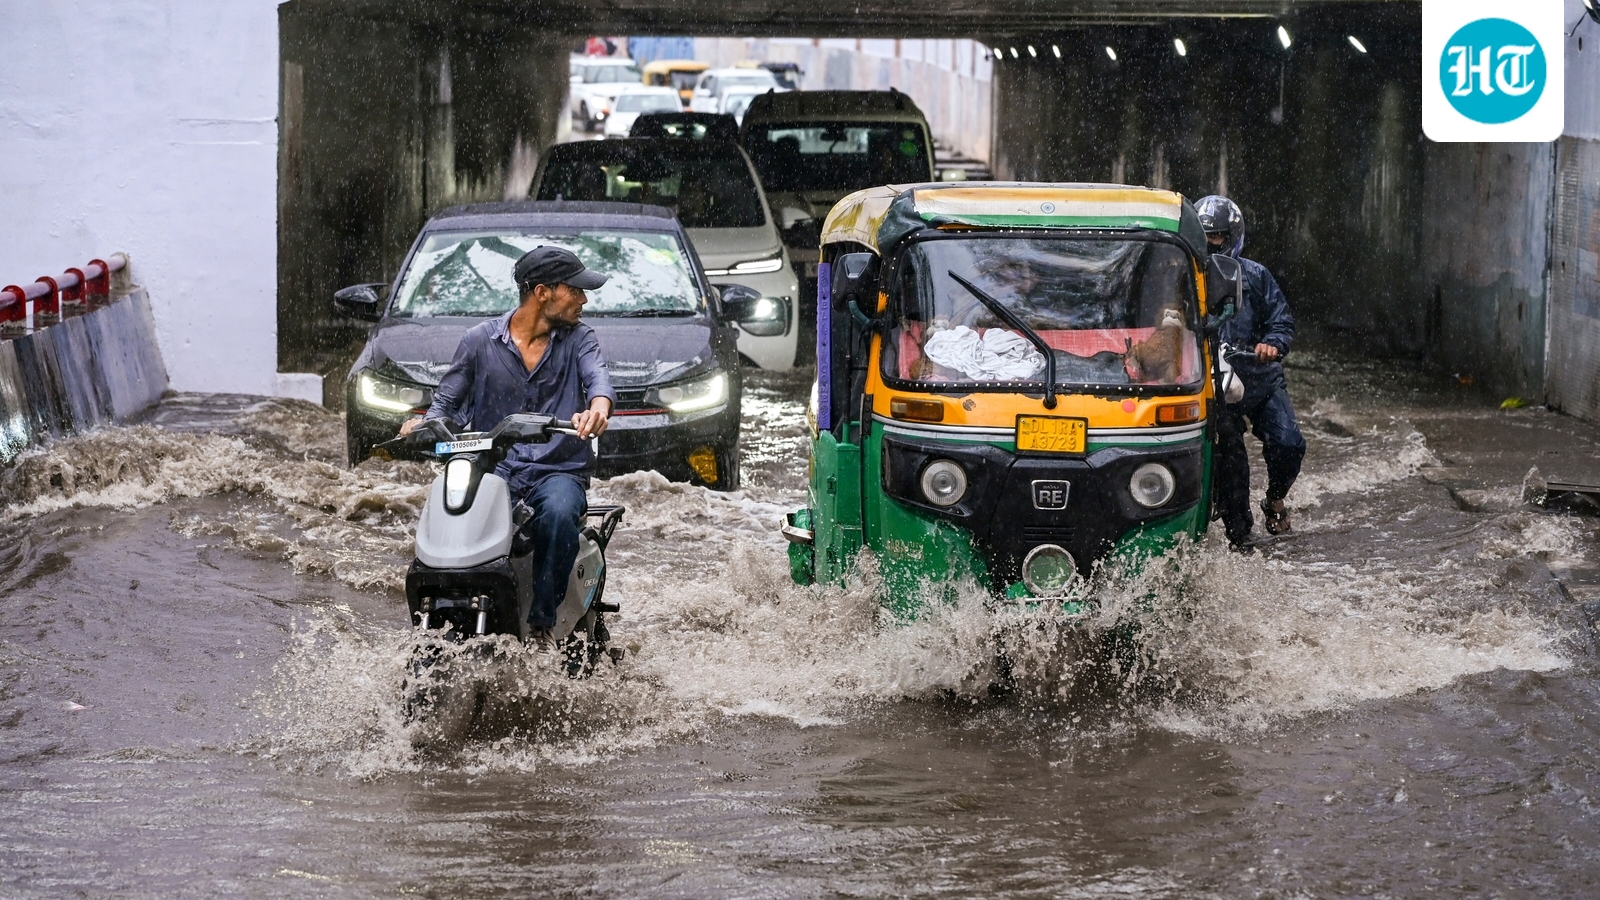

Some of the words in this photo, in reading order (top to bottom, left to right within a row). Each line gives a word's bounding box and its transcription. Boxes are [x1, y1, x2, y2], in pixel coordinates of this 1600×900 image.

[452, 441, 477, 449] 5105069
[1030, 435, 1076, 450] A3729
[1039, 490, 1063, 503] RE
